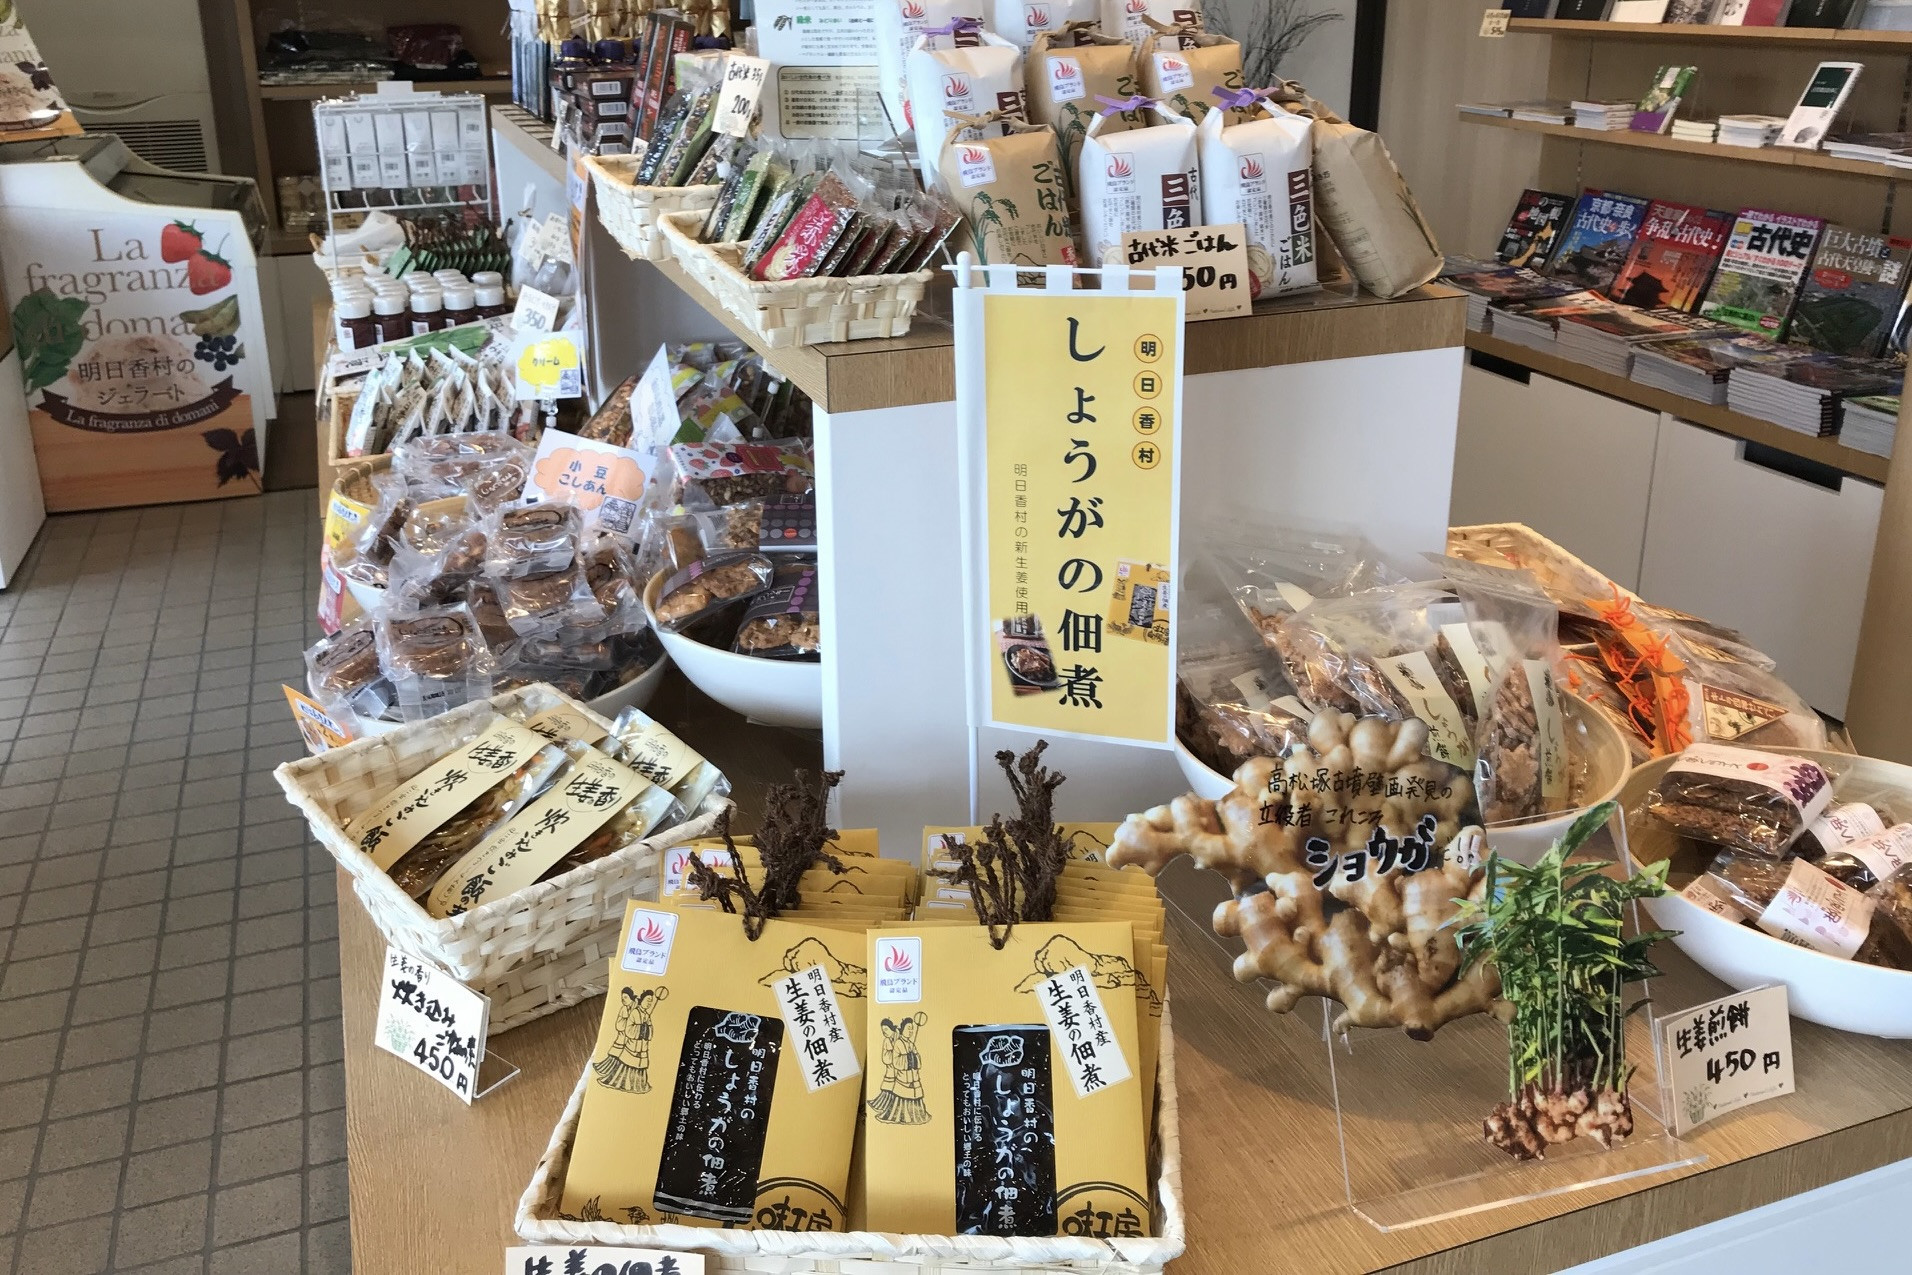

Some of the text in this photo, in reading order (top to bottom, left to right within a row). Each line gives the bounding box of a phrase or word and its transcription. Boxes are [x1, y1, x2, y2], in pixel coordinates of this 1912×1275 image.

[87, 228, 149, 262] La
[1290, 173, 1313, 266] 三色米
[1747, 222, 1814, 260] 古代史
[1279, 236, 1292, 286] ごはん
[78, 357, 195, 382] 明日香村の
[98, 383, 186, 406] ジェラート
[66, 401, 220, 432] La fragranza di domani
[1139, 339, 1158, 466] 明日香村
[558, 473, 607, 496] こしあん
[1056, 316, 1106, 709] しょうがの佃煮
[1014, 463, 1029, 615] 明日香村の新生姜使用
[1267, 766, 1453, 801] 高松塚古墳壁画発見の
[1258, 801, 1385, 828] 立役者 これこそ
[1306, 814, 1437, 891] ショウガ
[628, 945, 668, 961] 飛鳥ブランド
[879, 977, 918, 987] 飛鳥ブランド
[391, 978, 456, 1028] 炊き込み
[785, 976, 839, 1088] 生姜の佃煮
[806, 967, 846, 1044] 明日香村産
[1068, 968, 1113, 1048] 明日香村産
[1676, 1000, 1751, 1060] 生姜煎餅
[1047, 979, 1108, 1093] 生姜の佃煮
[413, 1037, 469, 1096] 450円
[739, 1047, 768, 1122] 明日香村の
[1706, 1048, 1781, 1085] 450円
[697, 1048, 742, 1198] しょうがの佃煮
[1020, 1067, 1040, 1145] 明日香村の
[994, 1073, 1019, 1231] しょうがの佃煮
